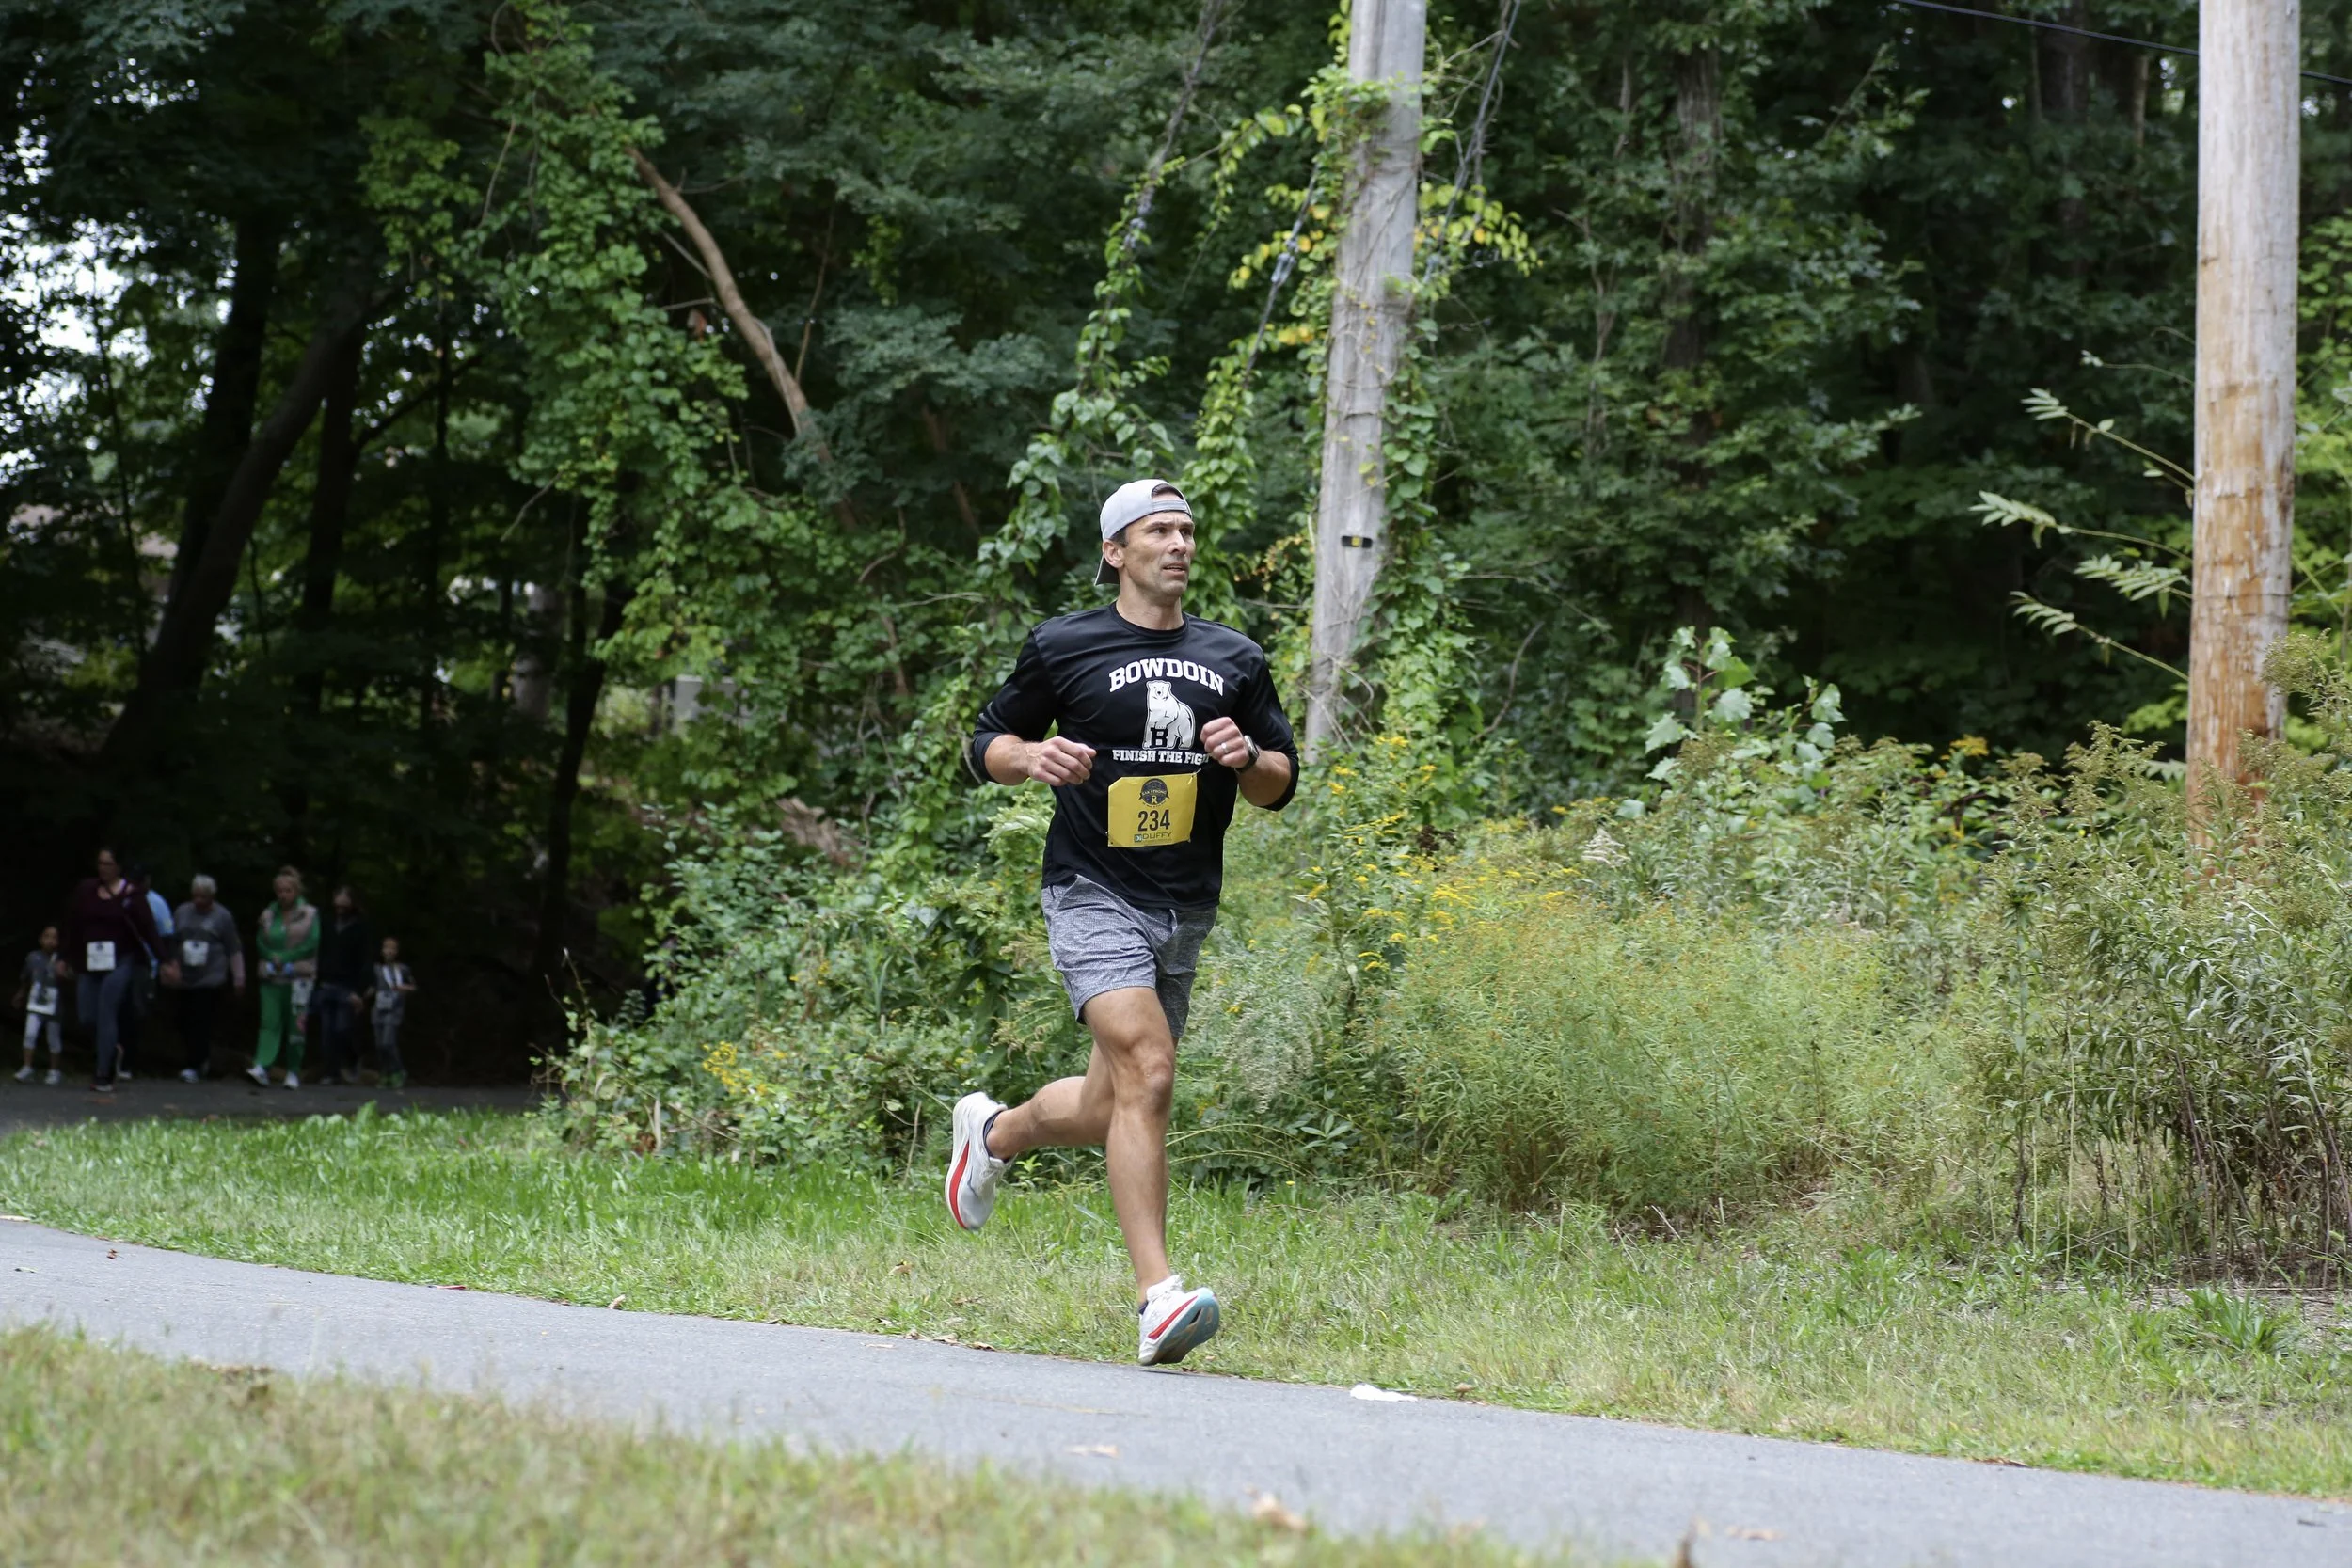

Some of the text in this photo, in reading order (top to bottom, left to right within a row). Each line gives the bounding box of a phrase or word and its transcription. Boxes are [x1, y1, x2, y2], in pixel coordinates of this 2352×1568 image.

[1109, 658, 1224, 696] BOWDOIN
[1151, 727, 1168, 747] B
[1112, 750, 1156, 762] FINISH
[1158, 751, 1183, 763] THE
[1138, 809, 1170, 832] 234
[1142, 832, 1173, 840] DUFFY
